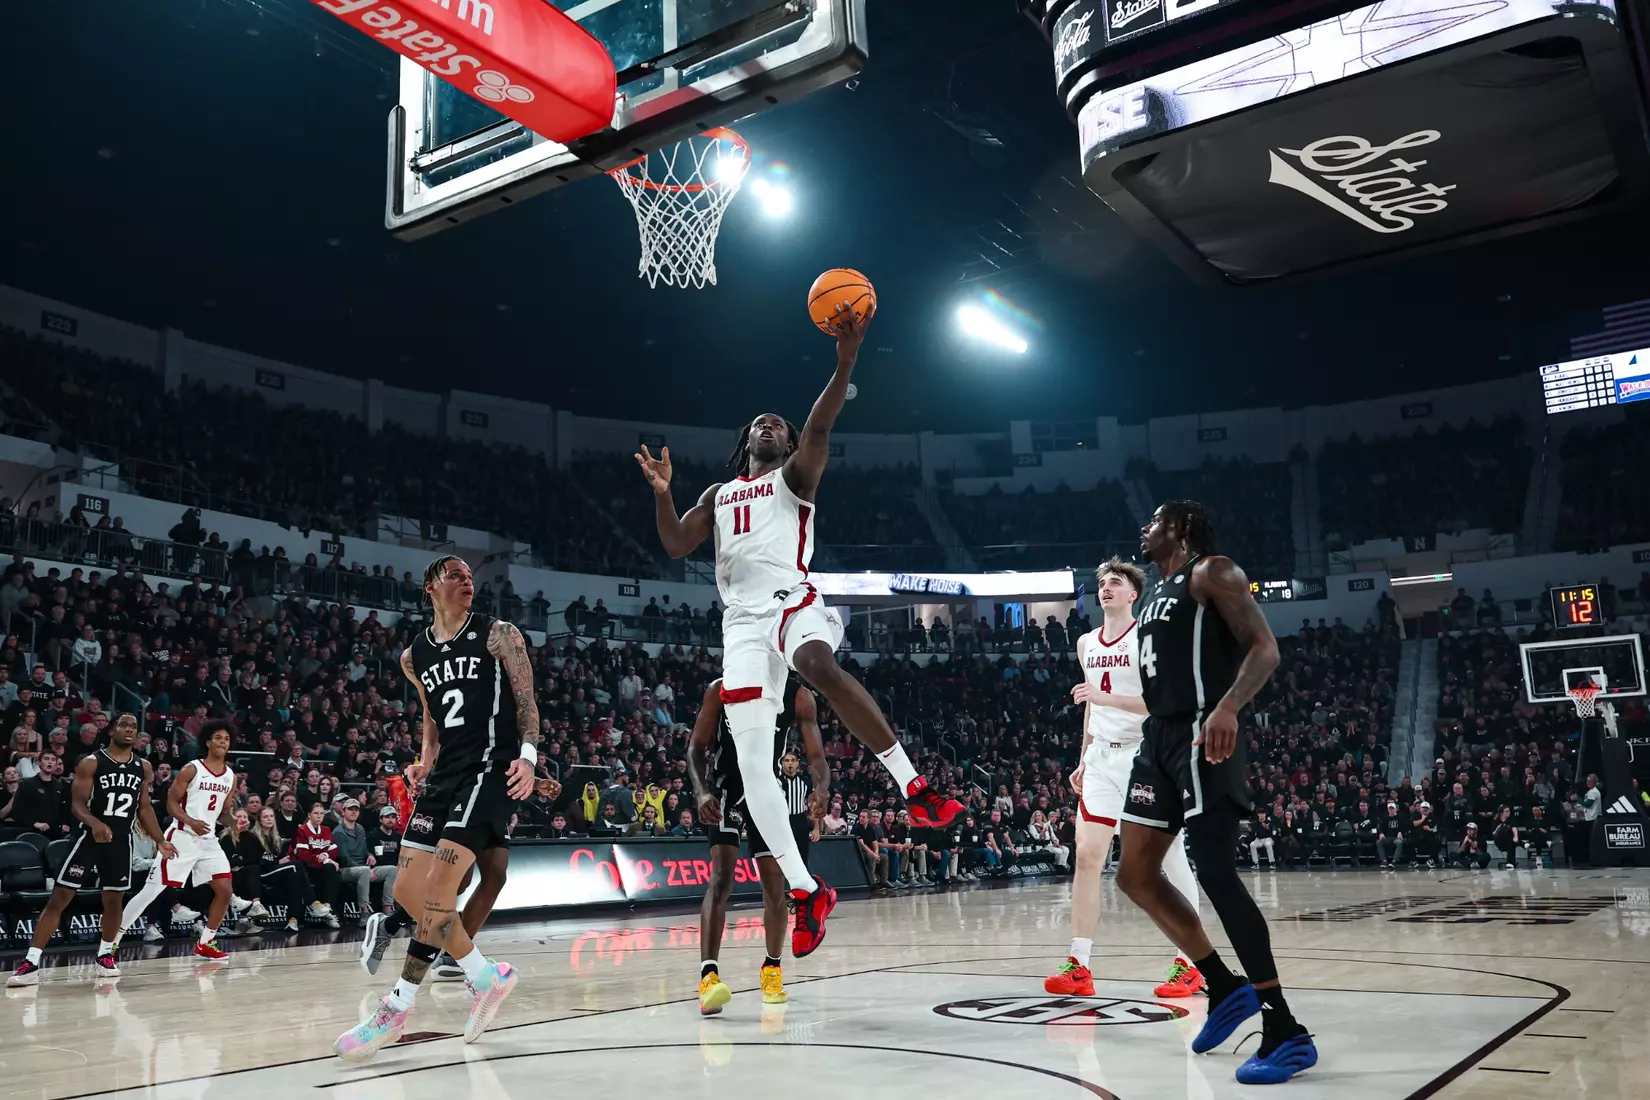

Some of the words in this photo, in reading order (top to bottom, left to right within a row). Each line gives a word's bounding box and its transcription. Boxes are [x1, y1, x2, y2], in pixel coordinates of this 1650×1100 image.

[1268, 129, 1457, 233] State
[85, 498, 102, 511] 116
[717, 483, 775, 508] ALABAMA
[733, 504, 751, 535] 11
[1414, 536, 1426, 550] N
[889, 574, 927, 592] MAKE
[927, 579, 962, 594] NOISE
[1281, 588, 1292, 599] 18
[1353, 581, 1369, 589] 120
[1560, 588, 1594, 603] 11:15
[1137, 597, 1178, 629] TATE
[1570, 601, 1592, 622] 12
[1086, 654, 1131, 669] ALABAMA
[1140, 633, 1157, 679] 4
[420, 656, 481, 693] STATE
[1100, 671, 1112, 694] 4
[441, 688, 465, 729] 2
[99, 772, 142, 795] STATE
[103, 792, 133, 818] 12
[207, 794, 217, 811] 2
[1608, 833, 1641, 841] BUREAU
[1617, 826, 1640, 834] FARM
